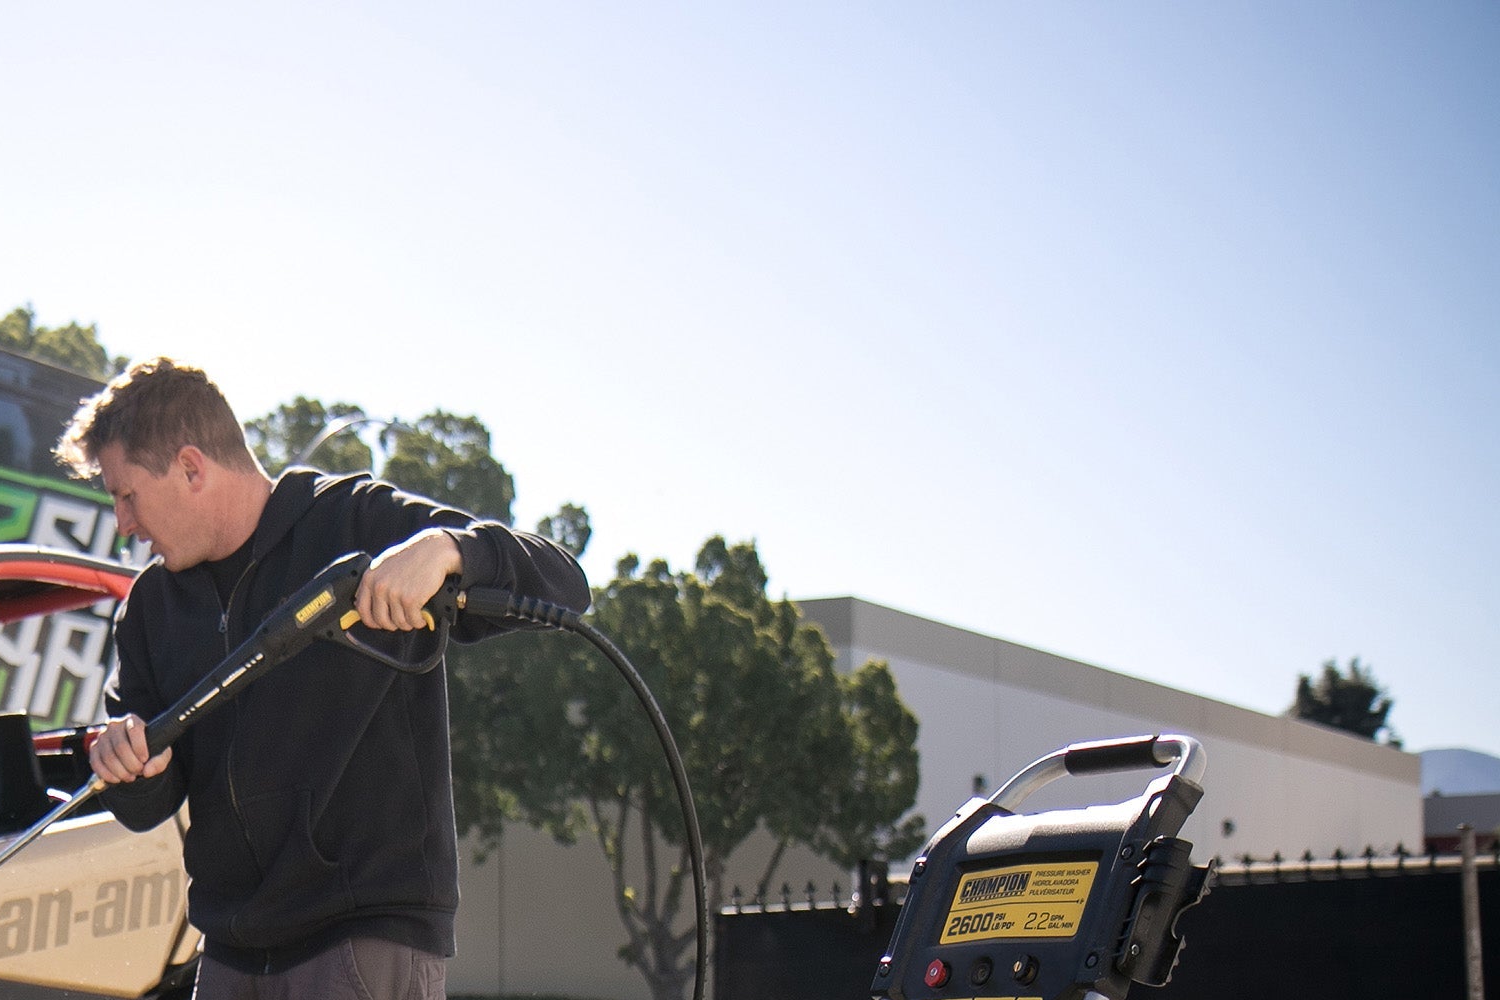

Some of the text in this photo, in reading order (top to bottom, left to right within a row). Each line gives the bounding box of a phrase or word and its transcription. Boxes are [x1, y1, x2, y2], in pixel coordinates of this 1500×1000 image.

[961, 871, 1032, 899] CHAMPION
[1035, 868, 1091, 877] PRESSURE WASHER
[947, 911, 994, 937] 2600
[994, 912, 1007, 921] PSI
[1023, 912, 1050, 930] 2.2
